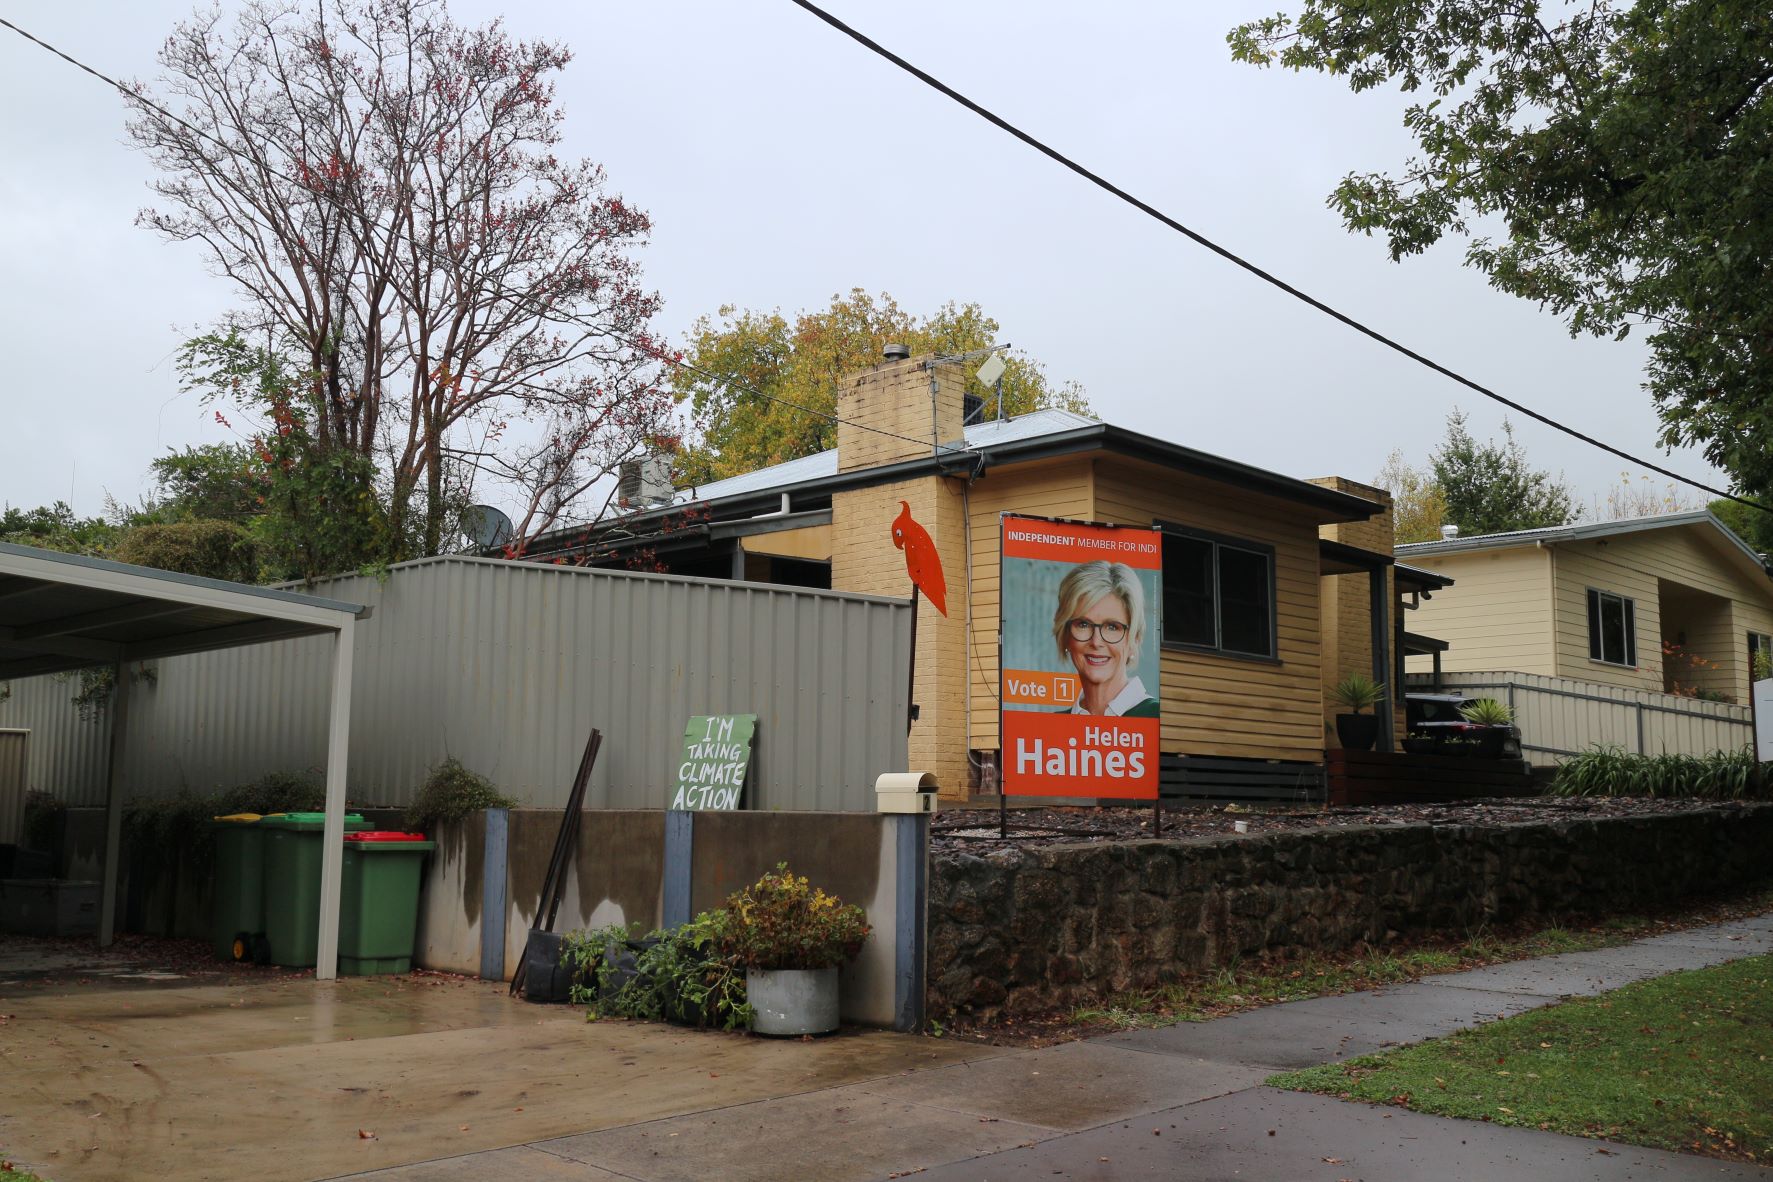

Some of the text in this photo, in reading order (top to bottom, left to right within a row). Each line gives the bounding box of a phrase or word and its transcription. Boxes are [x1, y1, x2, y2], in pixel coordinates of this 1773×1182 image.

[1008, 531, 1157, 554] INDEPENDENT MEMBER FOR INDI
[1007, 679, 1067, 697] Vote 1
[702, 716, 734, 742] I'M
[1085, 726, 1144, 748] Helen
[687, 743, 742, 761] TAKING
[1016, 737, 1145, 779] Haines
[678, 762, 745, 785] CLIMATE
[672, 785, 739, 810] ACTION
